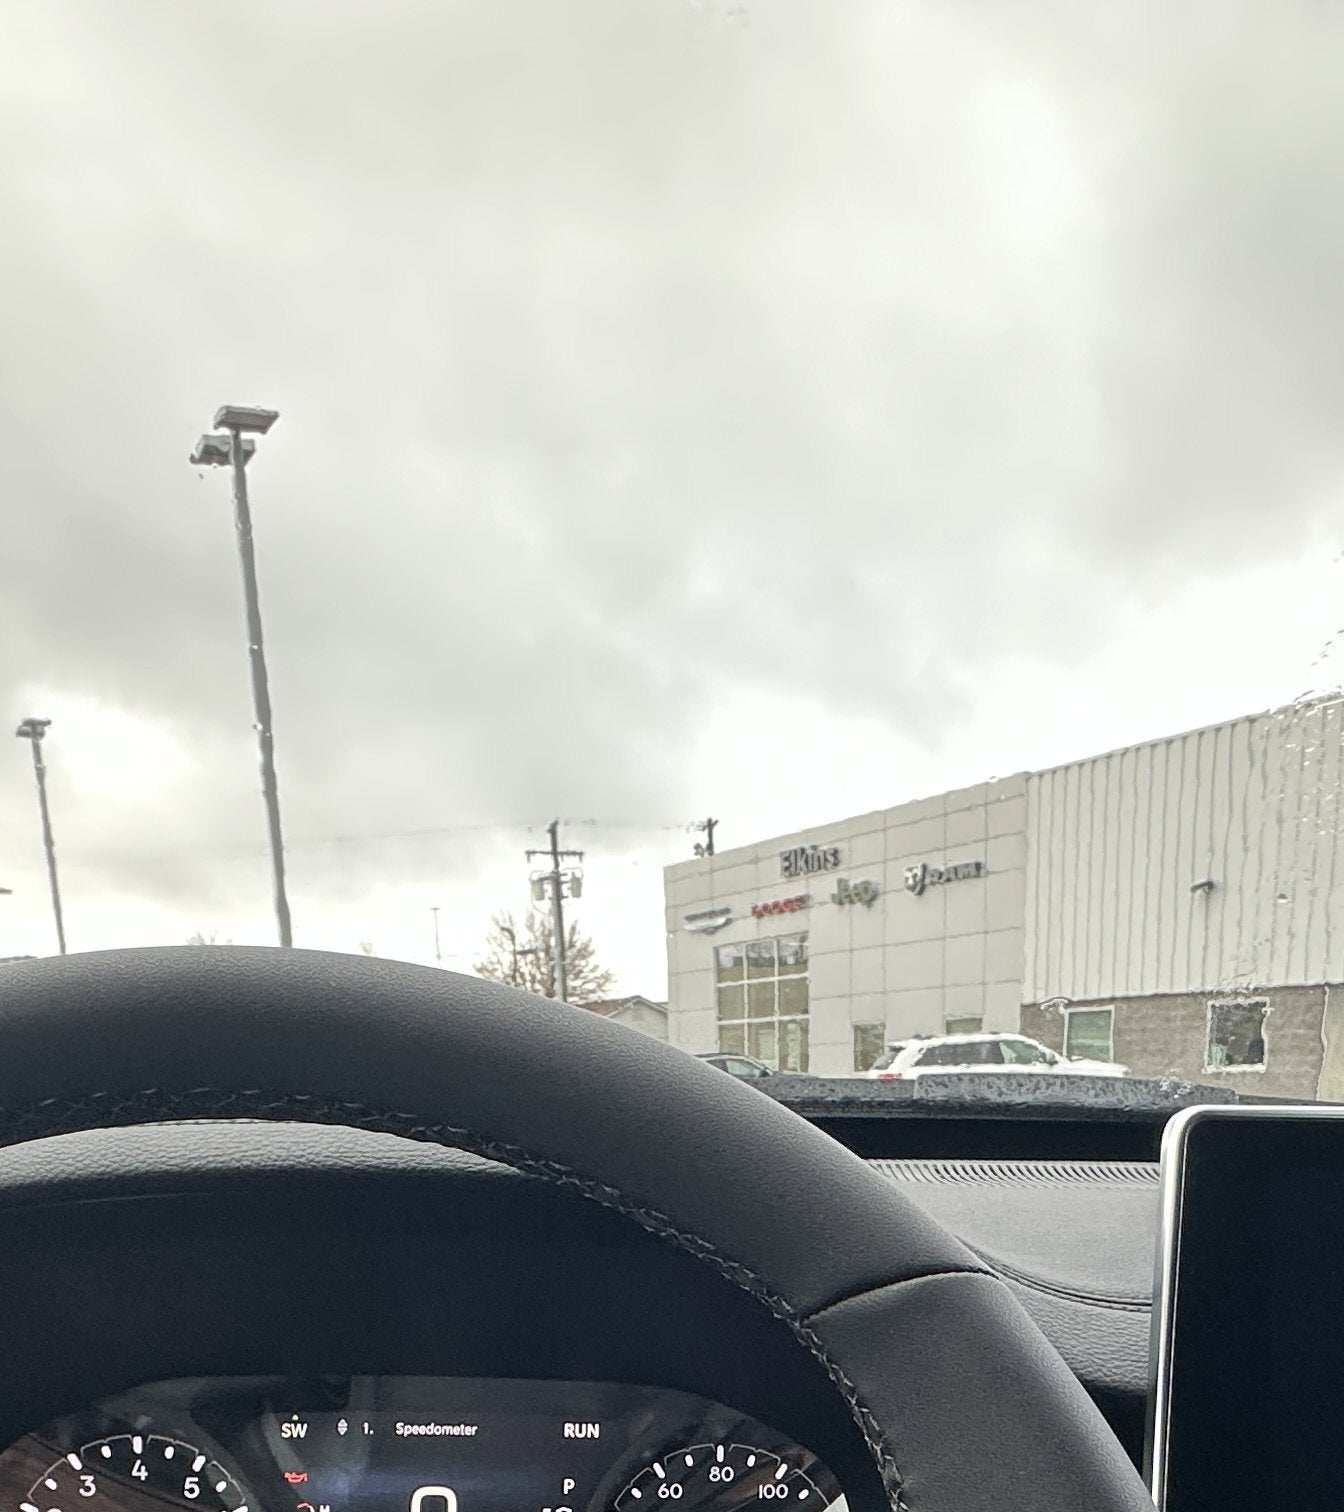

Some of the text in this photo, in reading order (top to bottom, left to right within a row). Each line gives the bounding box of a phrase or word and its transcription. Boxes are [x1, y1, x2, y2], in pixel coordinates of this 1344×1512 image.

[780, 844, 841, 878] Elkins
[924, 862, 988, 886] RAM
[751, 895, 808, 918] DODGE
[281, 1423, 308, 1438] SW
[362, 1422, 478, 1437] 1. Speedometer
[564, 1423, 600, 1439] RUN
[131, 1459, 149, 1481] 4
[708, 1466, 735, 1483] 80
[79, 1475, 97, 1497] 3
[183, 1477, 201, 1499] 5
[563, 1479, 575, 1495] P
[657, 1483, 683, 1499] 60
[758, 1484, 789, 1499] 100
